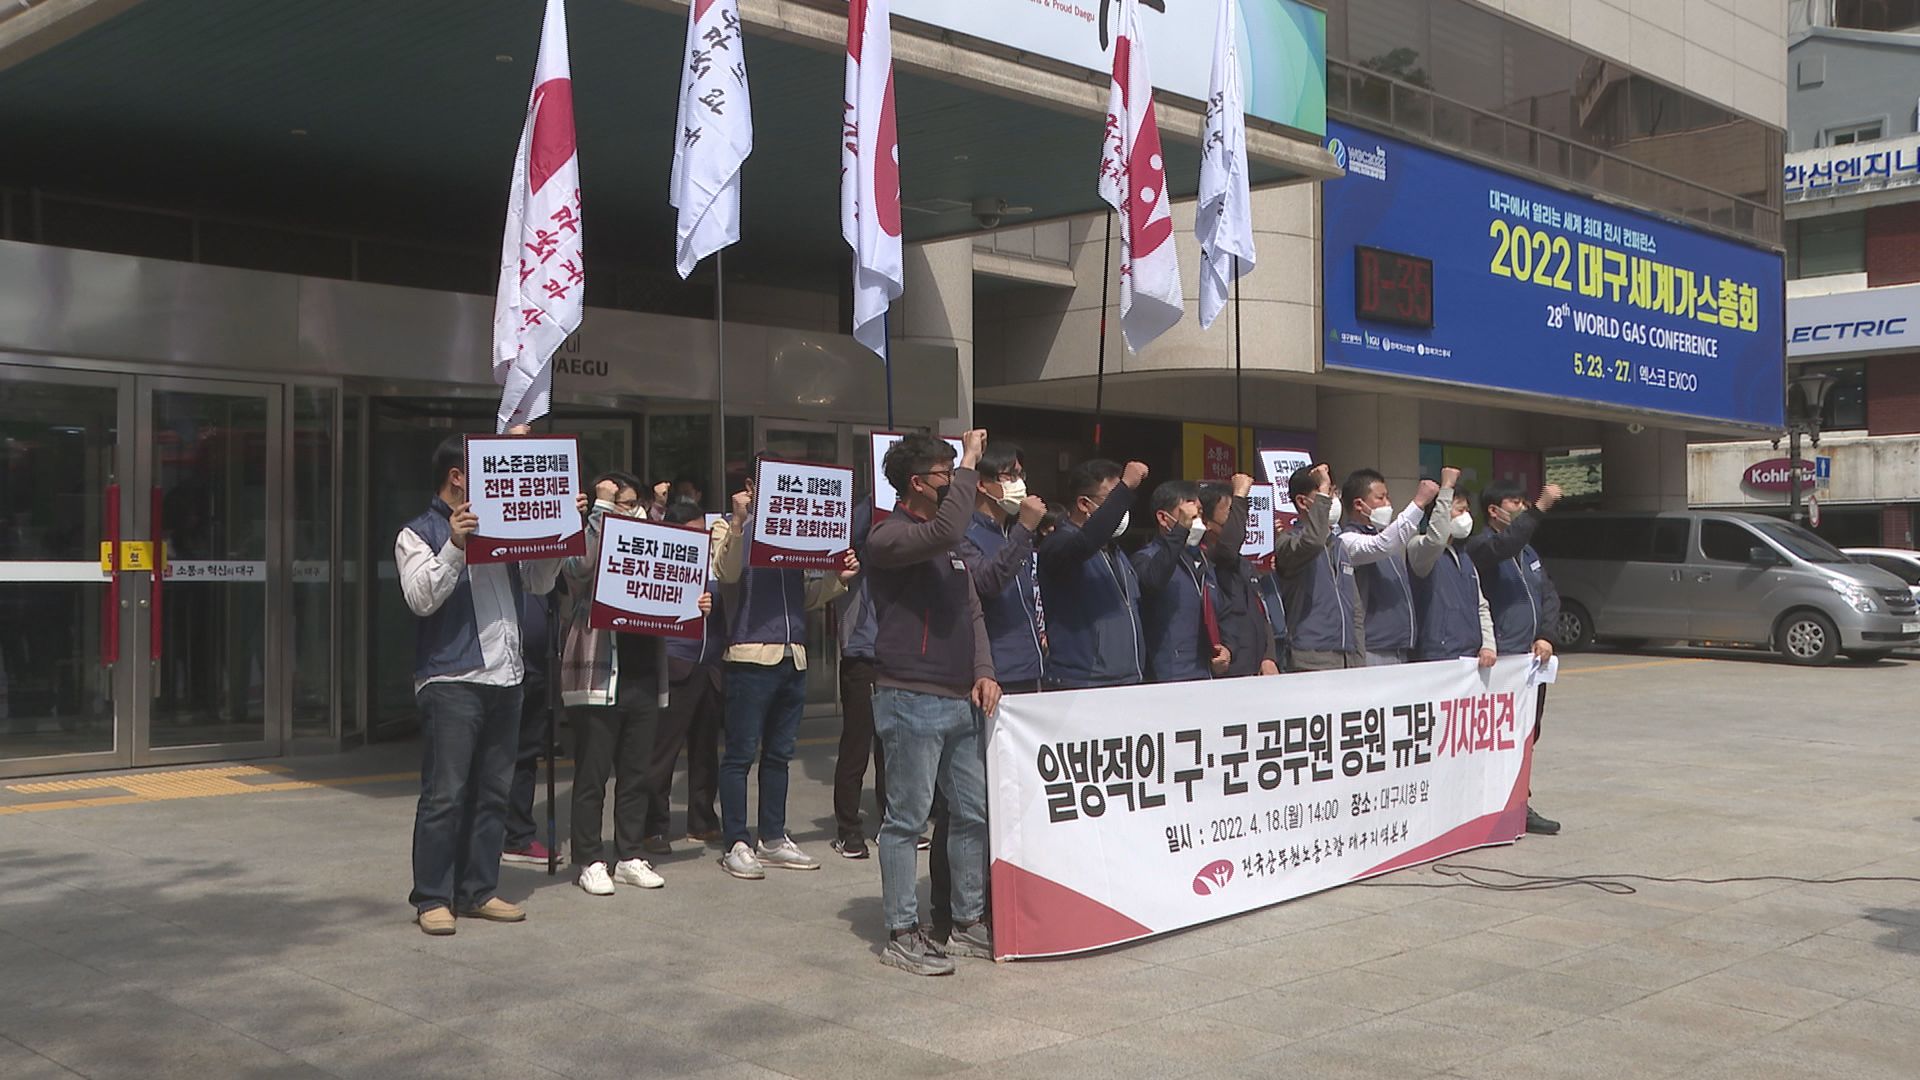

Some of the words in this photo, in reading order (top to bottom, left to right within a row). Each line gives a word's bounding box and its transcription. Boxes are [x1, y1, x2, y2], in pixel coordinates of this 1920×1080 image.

[1053, 0, 1072, 14] Proud
[1074, 6, 1094, 22] Daegu
[1489, 190, 1530, 220] 대구에서
[1532, 202, 1561, 228] 열리는
[1564, 212, 1582, 234] 세계
[1584, 217, 1601, 239] 최대
[1604, 222, 1621, 244] 전시
[1623, 226, 1656, 253] 컨퍼런스
[1489, 219, 1572, 292] 2022
[1578, 242, 1758, 332] 대구세계가스총회
[1547, 303, 1570, 328] 28th
[1573, 310, 1620, 339] WORLD
[1622, 321, 1646, 345] GAS
[1649, 327, 1718, 358] CONFERENCE
[1788, 317, 1907, 343] ECTRIC
[553, 358, 608, 376] AEGU
[1615, 359, 1632, 382] 27.
[1639, 365, 1666, 386] 엑스코
[1668, 369, 1698, 392] EXCO
[483, 454, 569, 474] 버스준공영제를
[1752, 468, 1815, 482] Kohlrbi
[485, 478, 514, 498] 전면
[519, 476, 570, 496] 공영제로
[778, 474, 803, 493] 버스
[807, 478, 842, 497] 파업에
[502, 500, 561, 522] 전환하라!
[769, 496, 808, 515] 공무원
[812, 499, 846, 518] 노동자
[765, 518, 792, 536] 동원
[796, 519, 846, 539] 철회하라!
[617, 535, 658, 558] 노동자
[662, 542, 699, 564] 파업을
[236, 566, 254, 576] 대구
[607, 556, 650, 578] 노동자
[653, 562, 702, 586] 동원해서
[626, 580, 682, 604] 막지마라!
[1038, 732, 1166, 824] 일방적인
[1256, 713, 1334, 790] 공무원
[1340, 707, 1386, 777] 동원
[1392, 702, 1435, 768] 규탄
[1438, 692, 1515, 758] 기자회견
[1166, 823, 1193, 853] 일시
[1211, 816, 1246, 842] 2022.
[1250, 814, 1261, 834] 4.
[1308, 800, 1338, 824] 14:00
[1351, 793, 1370, 816] 장소
[1380, 786, 1418, 809] 대구시청
[1420, 780, 1429, 802] 앞
[1242, 836, 1344, 878] 전국공무원노동조합
[1349, 820, 1408, 850] 대구지역본부
